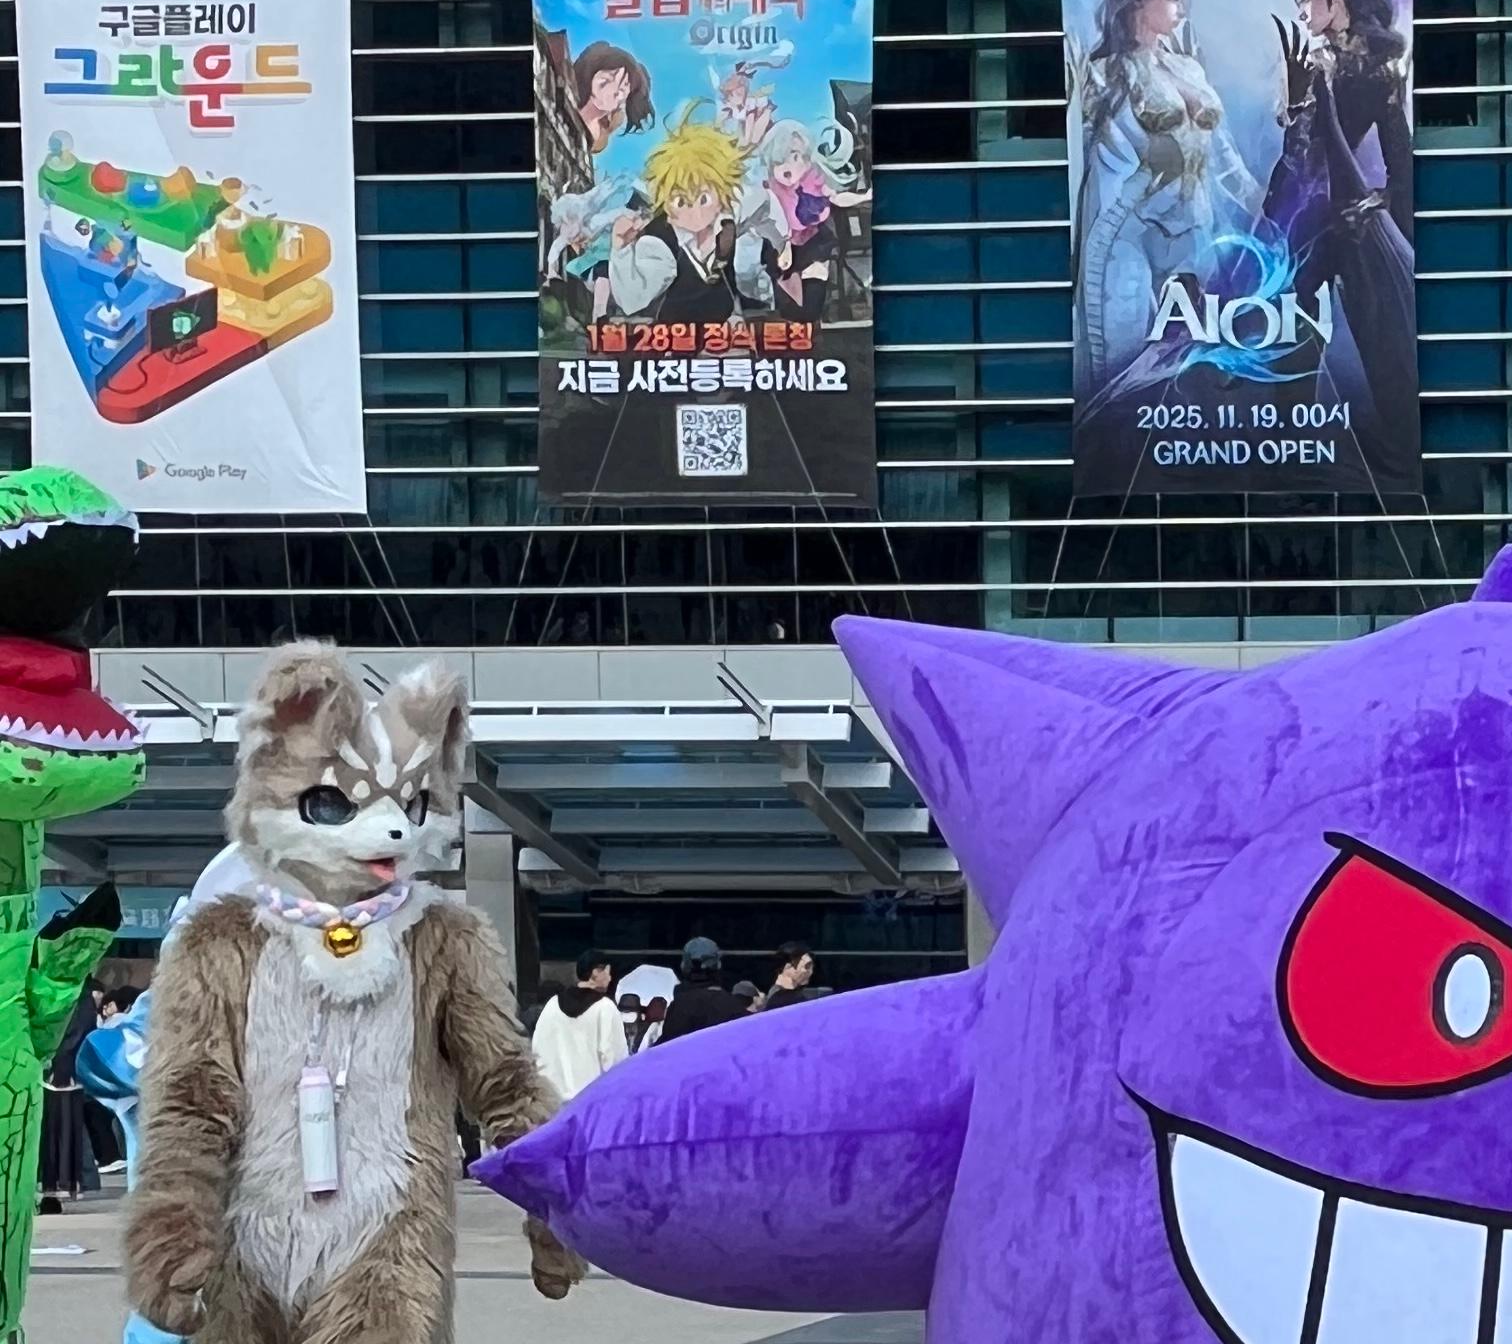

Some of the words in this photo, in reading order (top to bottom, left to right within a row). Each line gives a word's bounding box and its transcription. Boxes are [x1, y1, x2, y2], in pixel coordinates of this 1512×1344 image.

[98, 2, 256, 37] 구글플레이
[688, 19, 778, 50] Origin
[43, 44, 312, 128] 그라운드
[1145, 276, 1334, 350] AION
[632, 322, 697, 352] 28일
[703, 323, 756, 353] 정식
[558, 360, 621, 393] 지금
[627, 359, 848, 393] 사전등록하세요
[1137, 404, 1209, 429] 2025.
[1217, 405, 1244, 428] 11.
[1251, 404, 1285, 428] 19.
[1292, 402, 1350, 429] 00시
[1153, 440, 1251, 465] GRAND
[1257, 440, 1335, 464] OPEN
[164, 462, 215, 481] Google
